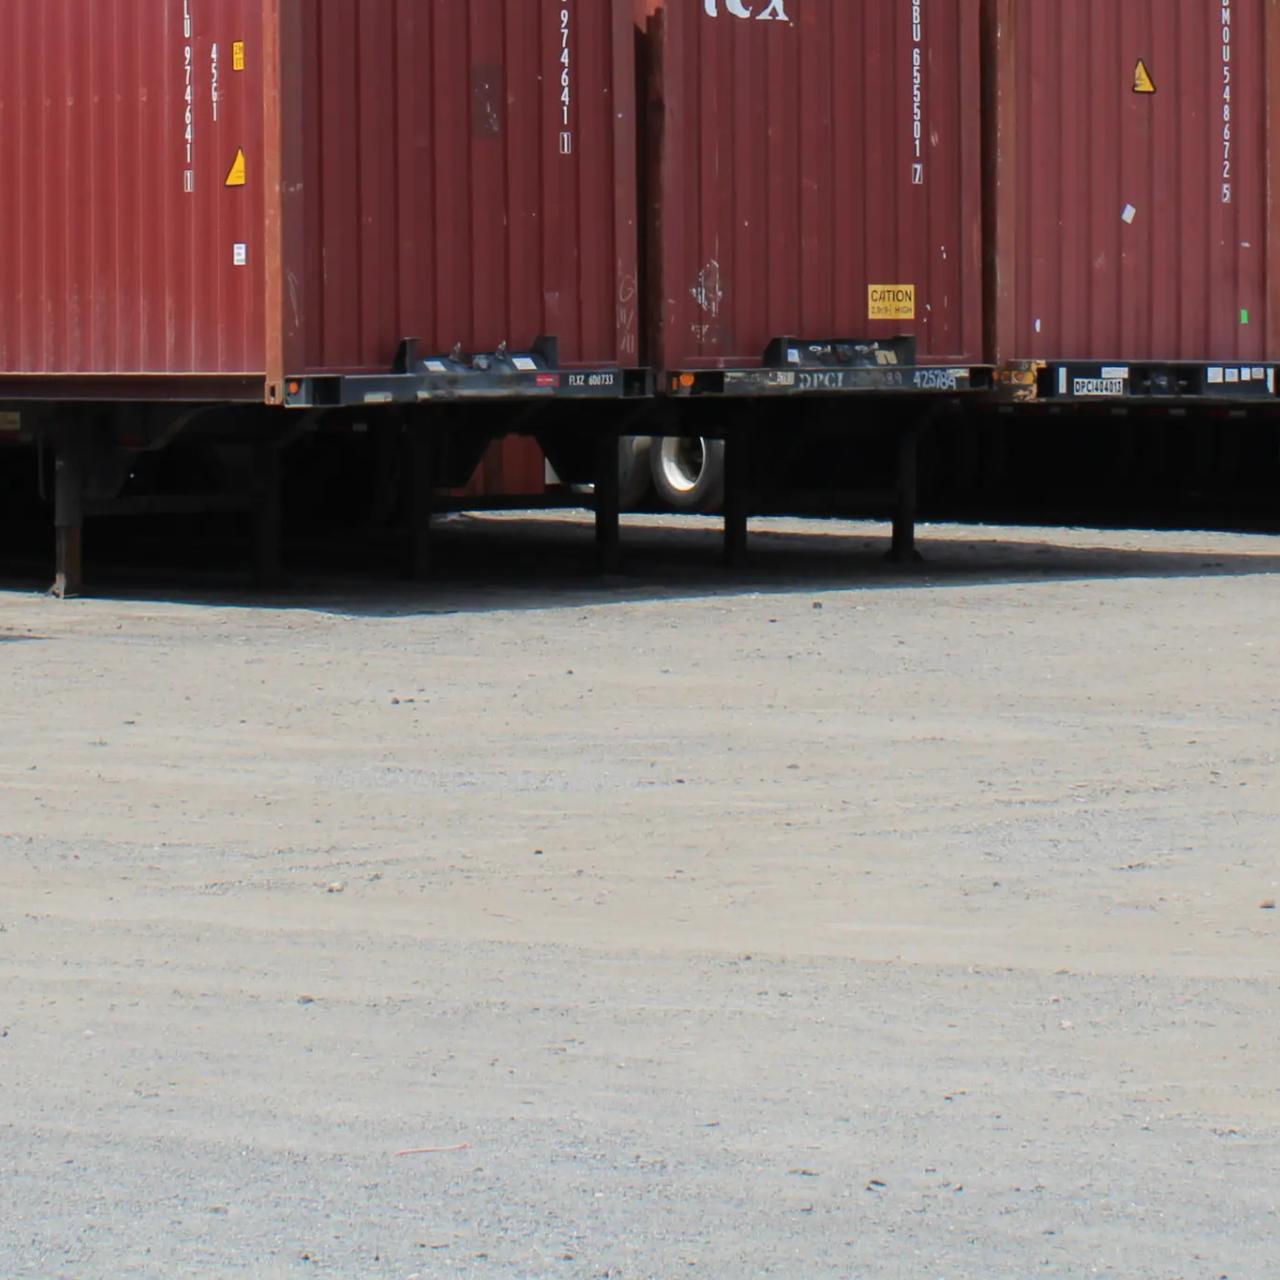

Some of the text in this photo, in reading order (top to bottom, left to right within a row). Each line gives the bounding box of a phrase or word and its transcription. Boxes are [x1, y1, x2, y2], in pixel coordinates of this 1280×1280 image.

[184, 45, 192, 163] 974641
[210, 43, 218, 122] 45G1
[560, 9, 570, 125] 974641
[912, 47, 921, 157] 655501
[1222, 66, 1231, 178] 548672
[912, 163, 923, 185] 7
[1222, 183, 1232, 203] 5
